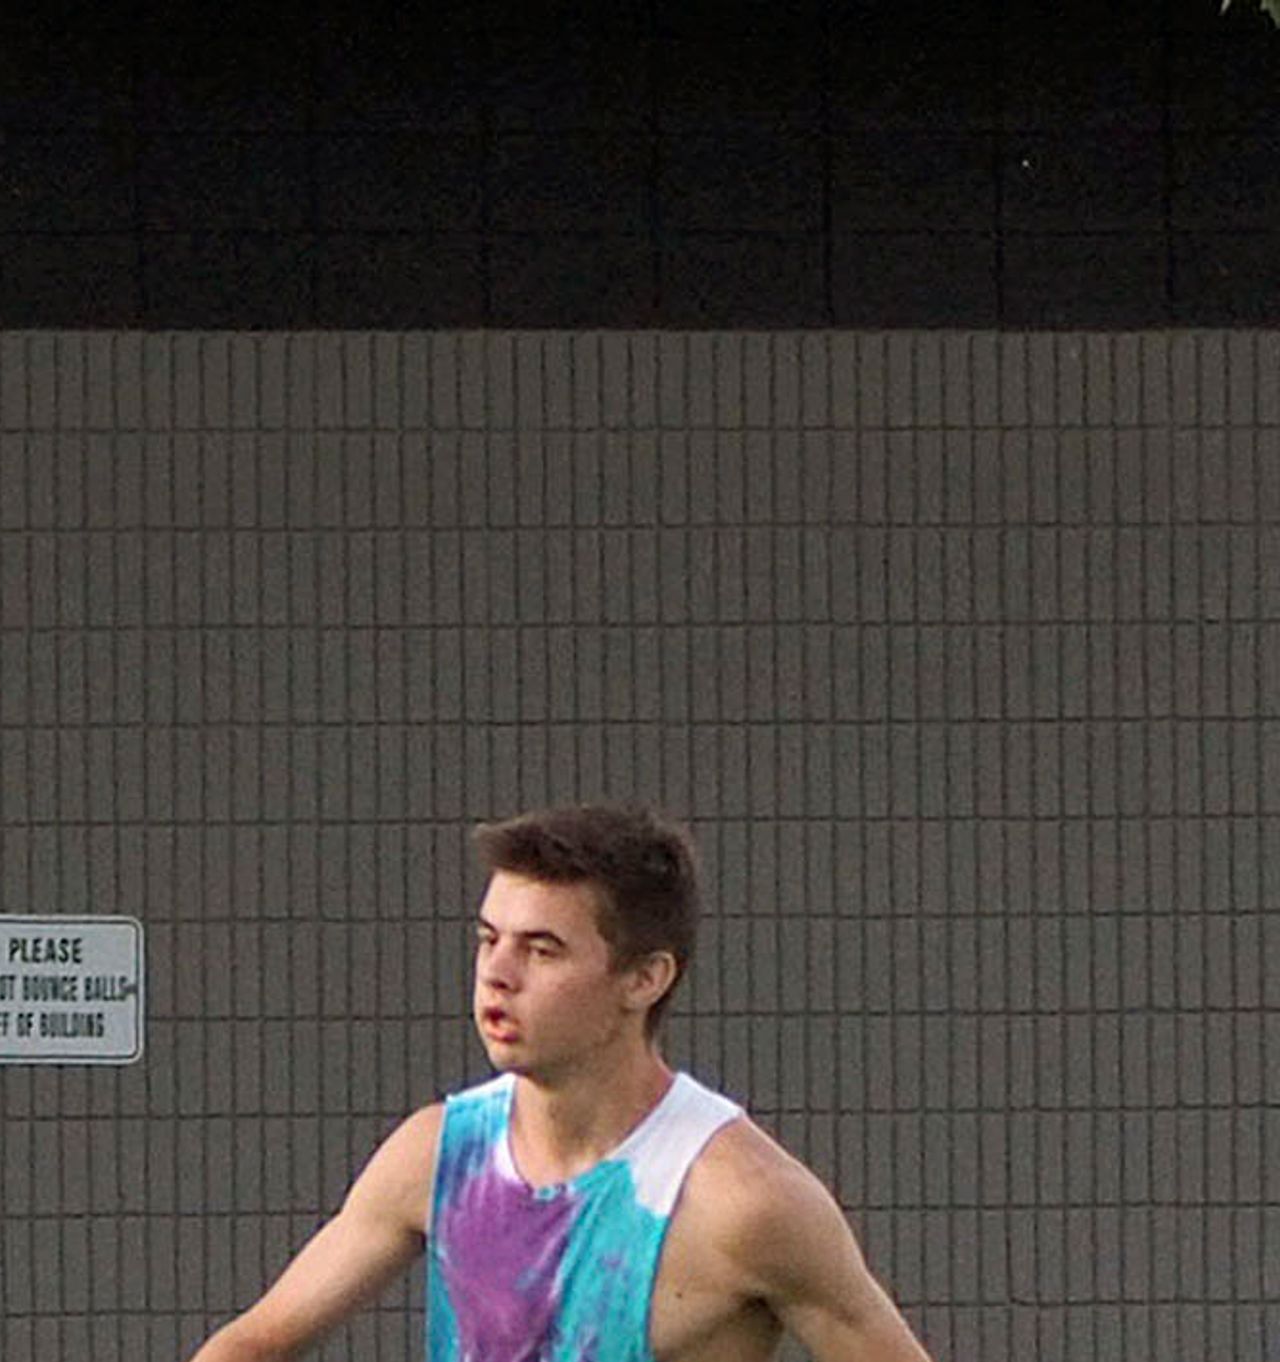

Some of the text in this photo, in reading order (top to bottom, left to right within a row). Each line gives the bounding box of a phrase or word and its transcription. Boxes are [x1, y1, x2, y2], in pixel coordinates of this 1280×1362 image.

[9, 938, 83, 964] PLEASE
[23, 975, 77, 1001] BOUNCE
[85, 975, 128, 1001] BALLS
[17, 1012, 34, 1037] OF
[41, 1012, 104, 1037] BUILDING
